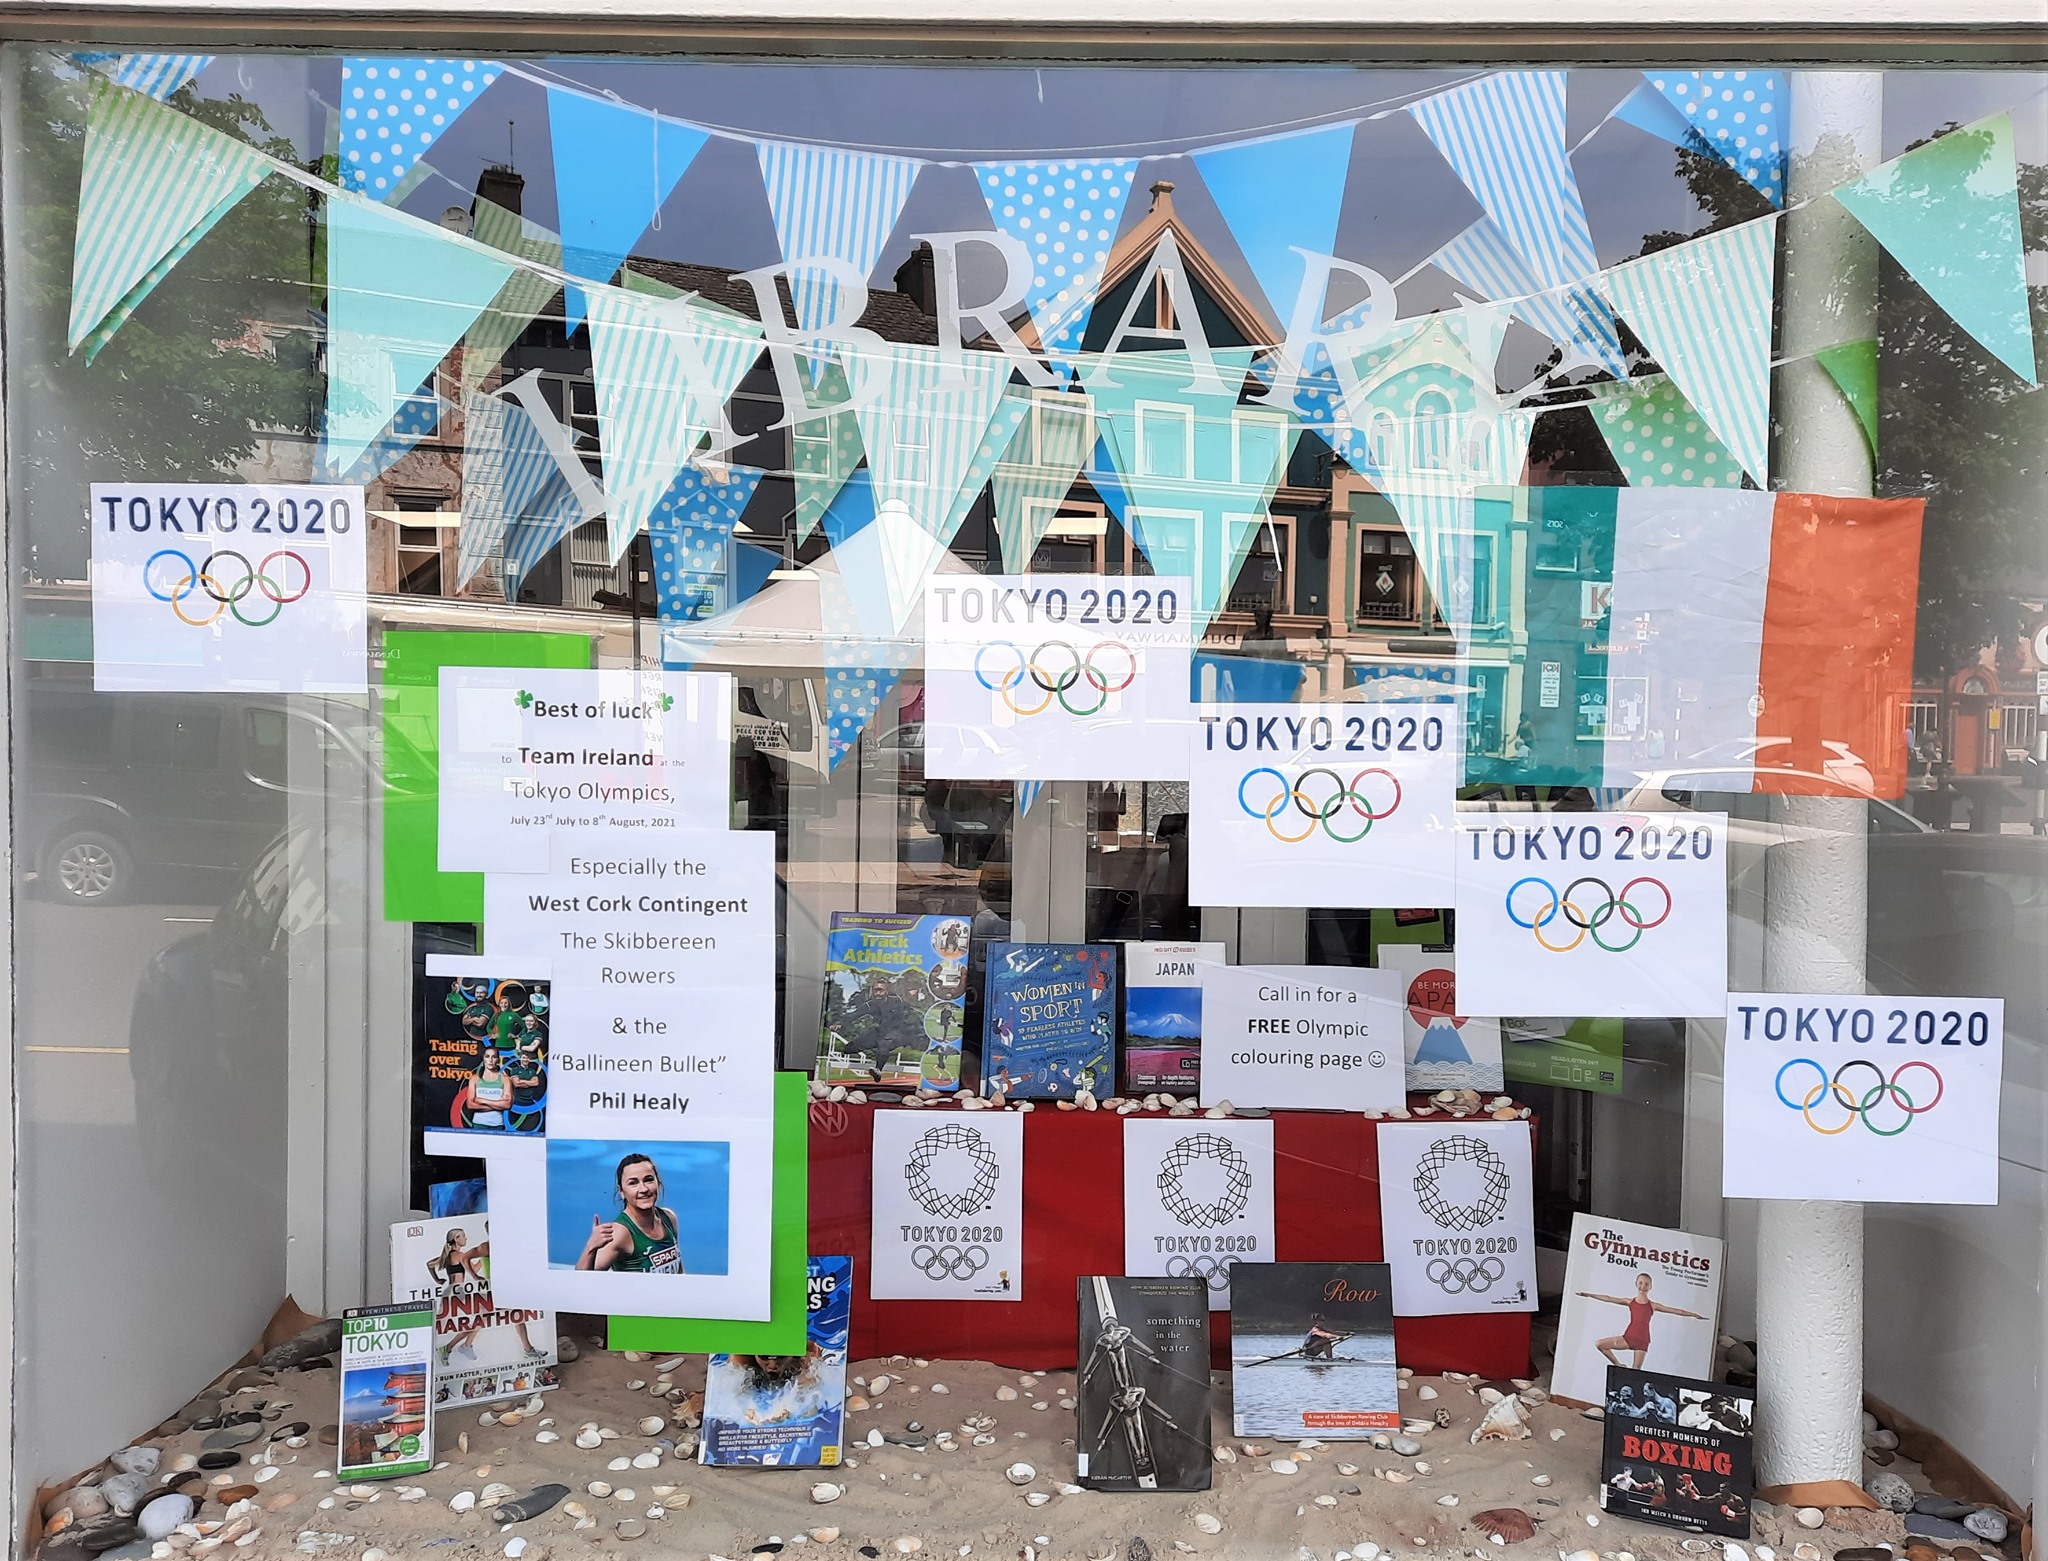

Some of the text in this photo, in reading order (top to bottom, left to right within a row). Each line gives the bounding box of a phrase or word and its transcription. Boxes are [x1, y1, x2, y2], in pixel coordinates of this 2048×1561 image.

[101, 497, 351, 534] TOKYO 2020
[935, 588, 1177, 624] TOKYO 2020
[534, 700, 653, 718] Best of luck
[1198, 716, 1443, 751] TOKYO 2020
[502, 755, 512, 764] to
[518, 748, 575, 765] Team
[583, 749, 654, 766] Ireland
[672, 759, 686, 767] the
[510, 782, 675, 804] Tokyo Olympics,
[510, 816, 530, 827] July
[555, 816, 576, 827] July
[579, 818, 589, 826] to
[592, 815, 606, 826] 8th
[609, 817, 648, 828] August,
[651, 817, 675, 827] 2021
[1467, 825, 1712, 860] TOKYO 2020
[571, 858, 706, 879] Especially the
[529, 895, 748, 916] West Cork Contingent
[560, 933, 716, 950] The Skibbereen
[861, 932, 908, 948] Track
[842, 949, 923, 965] Athletics
[601, 967, 676, 984] Rowers
[1156, 963, 1195, 976] JAPAN
[1010, 982, 1086, 1003] WOMEN IN
[1259, 986, 1357, 1003] Call in for a
[1418, 981, 1455, 990] BE MOR
[1406, 991, 1455, 1010] APA
[1020, 999, 1083, 1023] SPORT
[612, 1017, 667, 1034] & the
[1249, 1019, 1369, 1039] FREE Olympic
[1738, 1006, 1988, 1046] TOKYO 2020
[429, 1039, 478, 1055] Taking
[429, 1055, 461, 1066] over
[1231, 1049, 1362, 1070] colouring page
[429, 1067, 473, 1082] Tokyo
[589, 1092, 689, 1114] Phil Healy
[901, 1226, 1003, 1243] TOKYO 2020
[1602, 1229, 1623, 1242] The
[1154, 1236, 1257, 1252] TOKYO 2020
[1413, 1237, 1517, 1256] TOKYO 2020
[1584, 1232, 1710, 1271] Gymnastics
[653, 1251, 677, 1266] SPAR
[1607, 1254, 1638, 1269] Book
[410, 1281, 490, 1300] THE COM
[1323, 1278, 1382, 1304] Row
[361, 1306, 402, 1315] EYEWITNESS
[404, 1303, 429, 1312] TRAVEL
[1146, 1315, 1201, 1328] something
[346, 1331, 408, 1354] TOKYO
[1156, 1330, 1181, 1339] in the
[1160, 1344, 1189, 1353] water
[517, 1360, 546, 1369] SMARTER
[1634, 1424, 1720, 1447] GREATEST MOMENTS OF
[1623, 1434, 1733, 1476] BOXING
